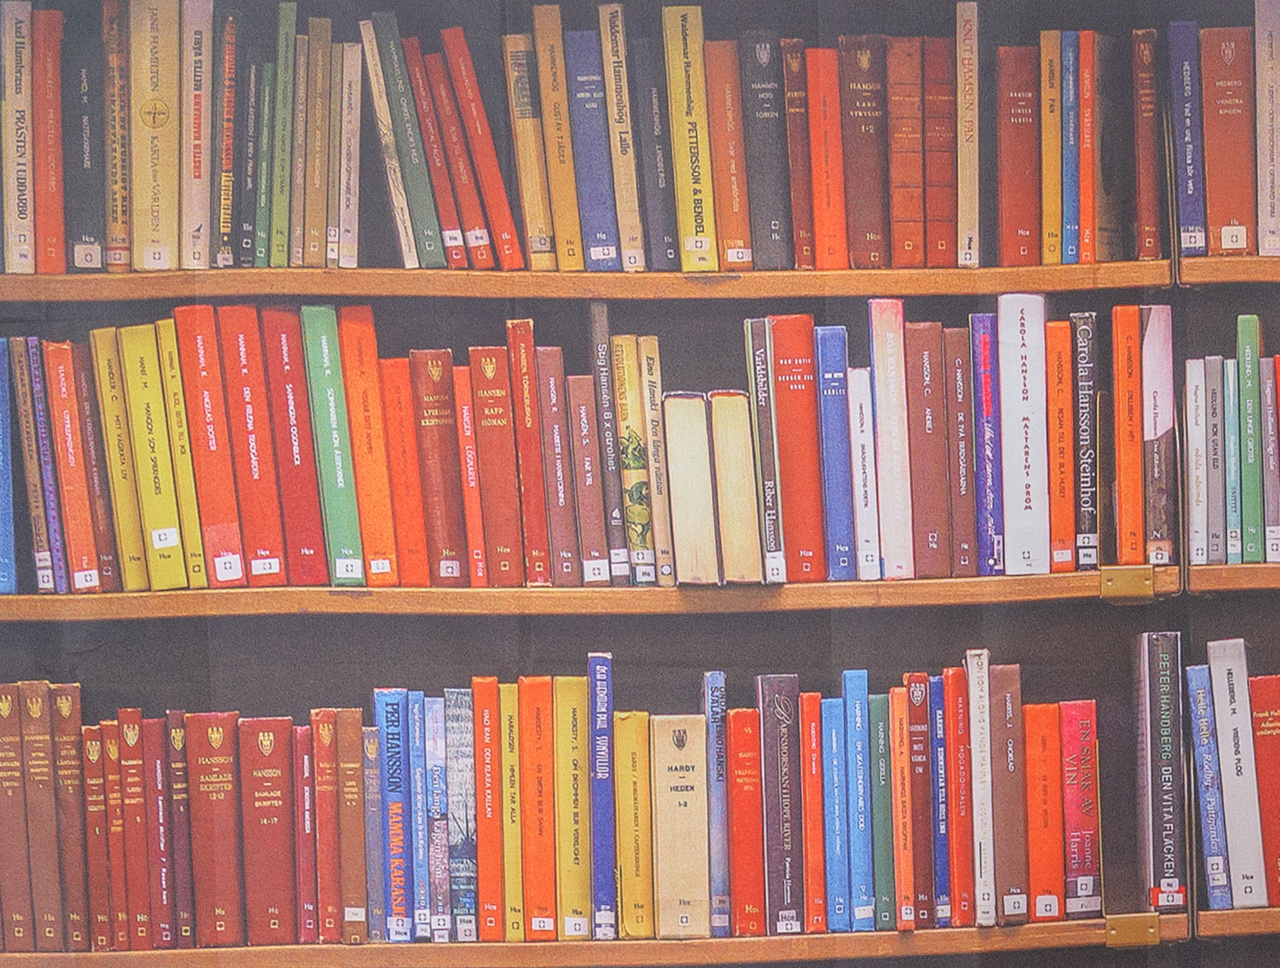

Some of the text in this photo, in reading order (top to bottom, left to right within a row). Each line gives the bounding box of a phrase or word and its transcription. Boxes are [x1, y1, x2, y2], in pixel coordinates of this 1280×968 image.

[14, 18, 26, 39] Axel
[149, 8, 159, 33] JANE
[963, 19, 974, 55] KNUT
[150, 36, 159, 92] HAMILTON
[15, 110, 27, 158] PRÄSTEN
[964, 120, 974, 143] PAN
[150, 136, 159, 168] KARTA
[688, 121, 701, 184] PETTERSSON
[16, 169, 27, 220] UDDARBO
[150, 184, 160, 232] VÄRLDEN
[693, 199, 705, 236] BENDEL
[596, 344, 608, 365] Stig
[600, 368, 611, 407] Hansén
[650, 419, 660, 437] Den
[1077, 325, 1096, 515] Carola Hansson Steinhof
[605, 431, 617, 471] otrohet
[755, 349, 777, 551] Världsbilder Riber Hansson
[654, 466, 664, 496] väntan
[482, 709, 491, 725] HAO
[1195, 689, 1208, 716] Helle
[483, 727, 492, 743] RAN
[1198, 718, 1210, 745] Helle
[484, 748, 492, 763] DEN
[716, 747, 724, 782] HANSKI
[1065, 754, 1078, 785] VIN
[1078, 720, 1093, 818] EN SMAK AV
[1158, 654, 1176, 878] PETER HANDBERG DEN VITA FLÄCKEN
[385, 702, 406, 917] PER HANSSON MAMMA KARASJO
[1204, 797, 1220, 854] Puttgarden
[1069, 831, 1080, 869] Harris
[1081, 830, 1094, 870] Joanne
